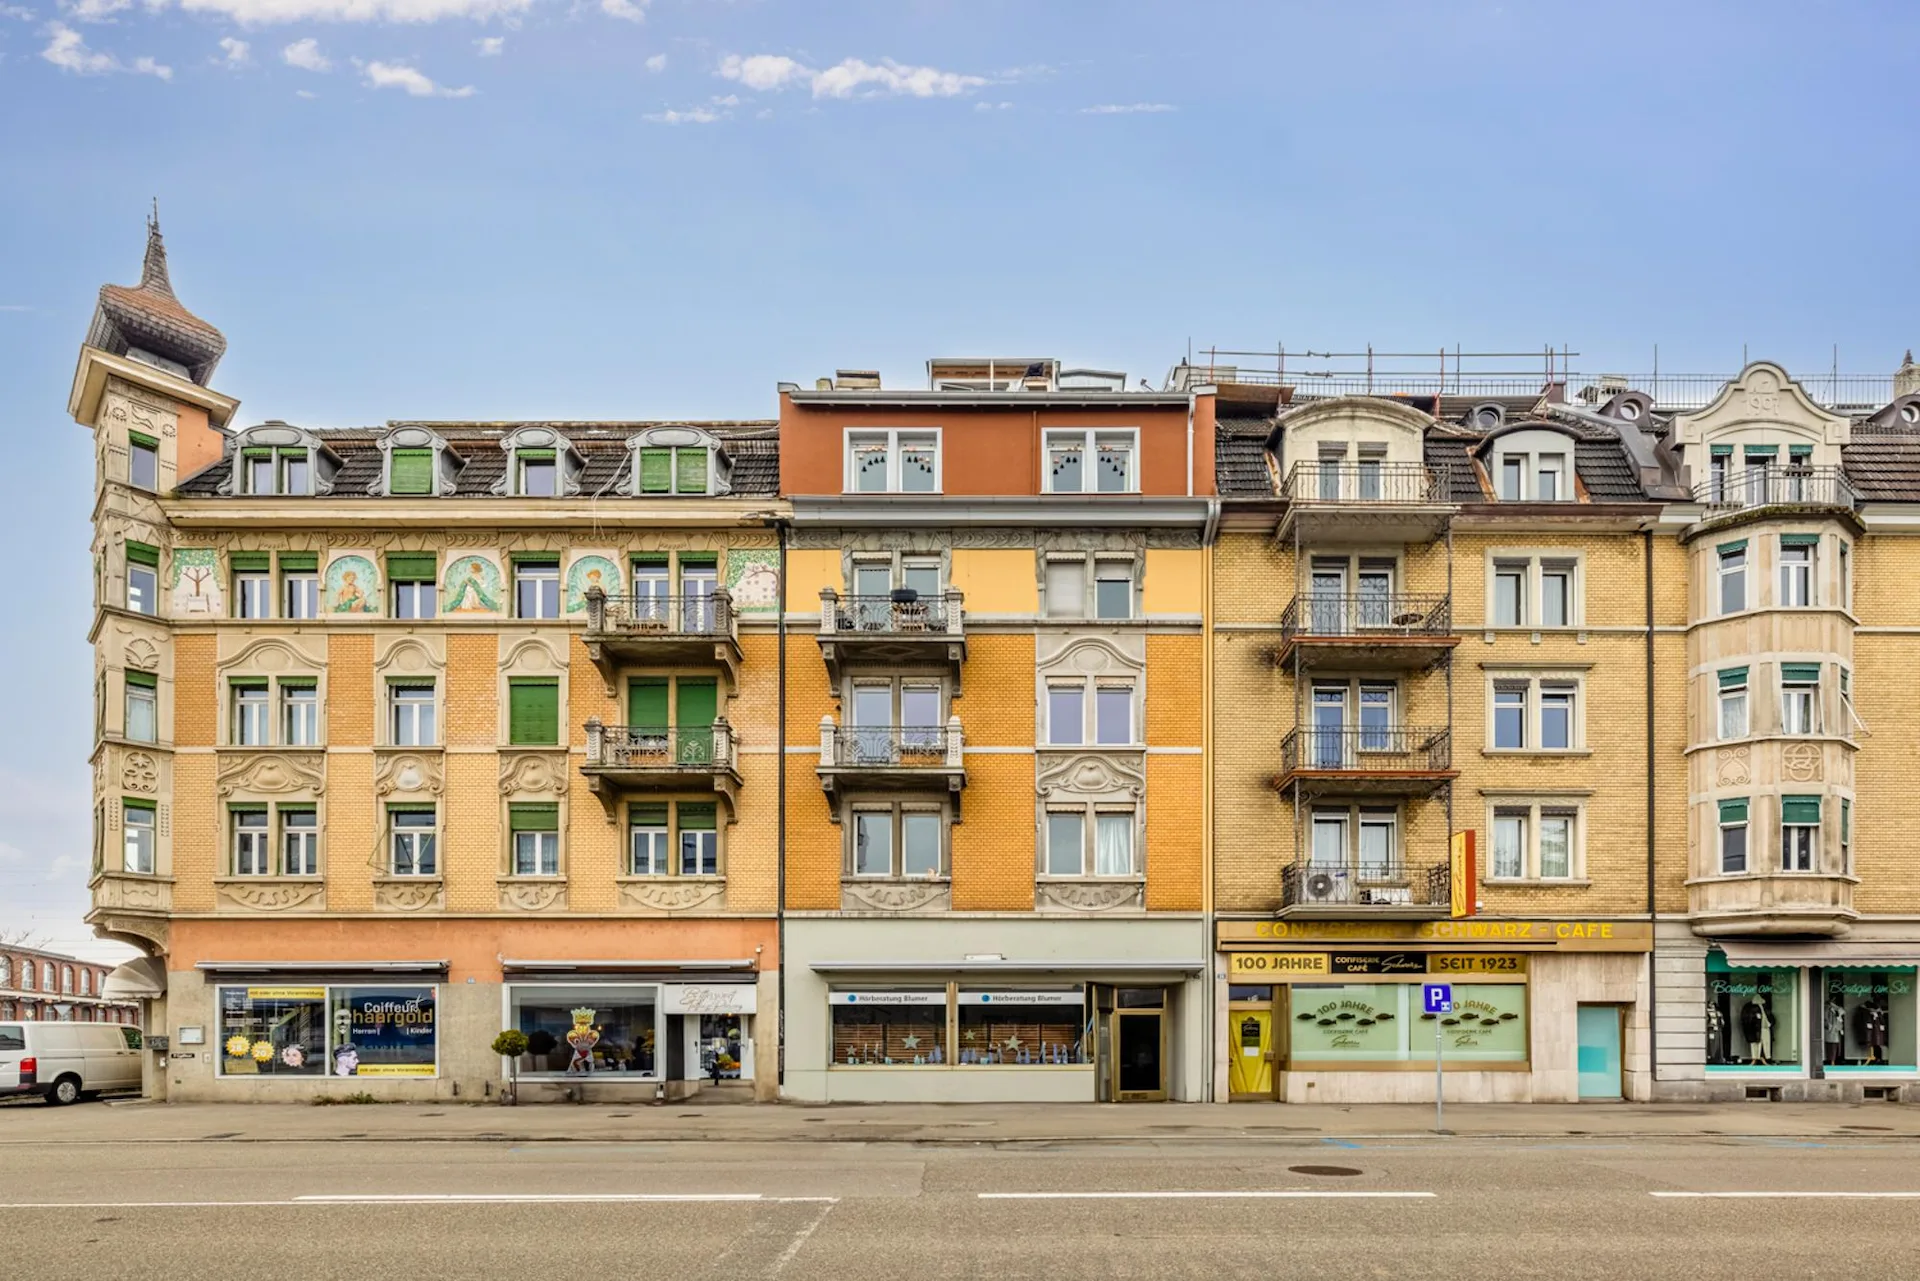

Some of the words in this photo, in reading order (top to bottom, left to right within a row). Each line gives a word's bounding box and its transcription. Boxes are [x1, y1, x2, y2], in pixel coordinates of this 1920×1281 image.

[1421, 922, 1531, 938] SCHWARZ
[1556, 923, 1613, 938] CAFE
[1236, 957, 1267, 970] 100
[1271, 957, 1323, 970] JAHRE
[1440, 957, 1475, 969] SEIT
[1480, 957, 1517, 969] 1923
[1430, 987, 1443, 1007] P
[364, 1002, 419, 1014] Coiffeur
[1317, 1001, 1337, 1015] 100
[1340, 1000, 1375, 1015] JAHRE
[1464, 1000, 1498, 1015] JAHRE
[352, 1009, 433, 1028] haargold
